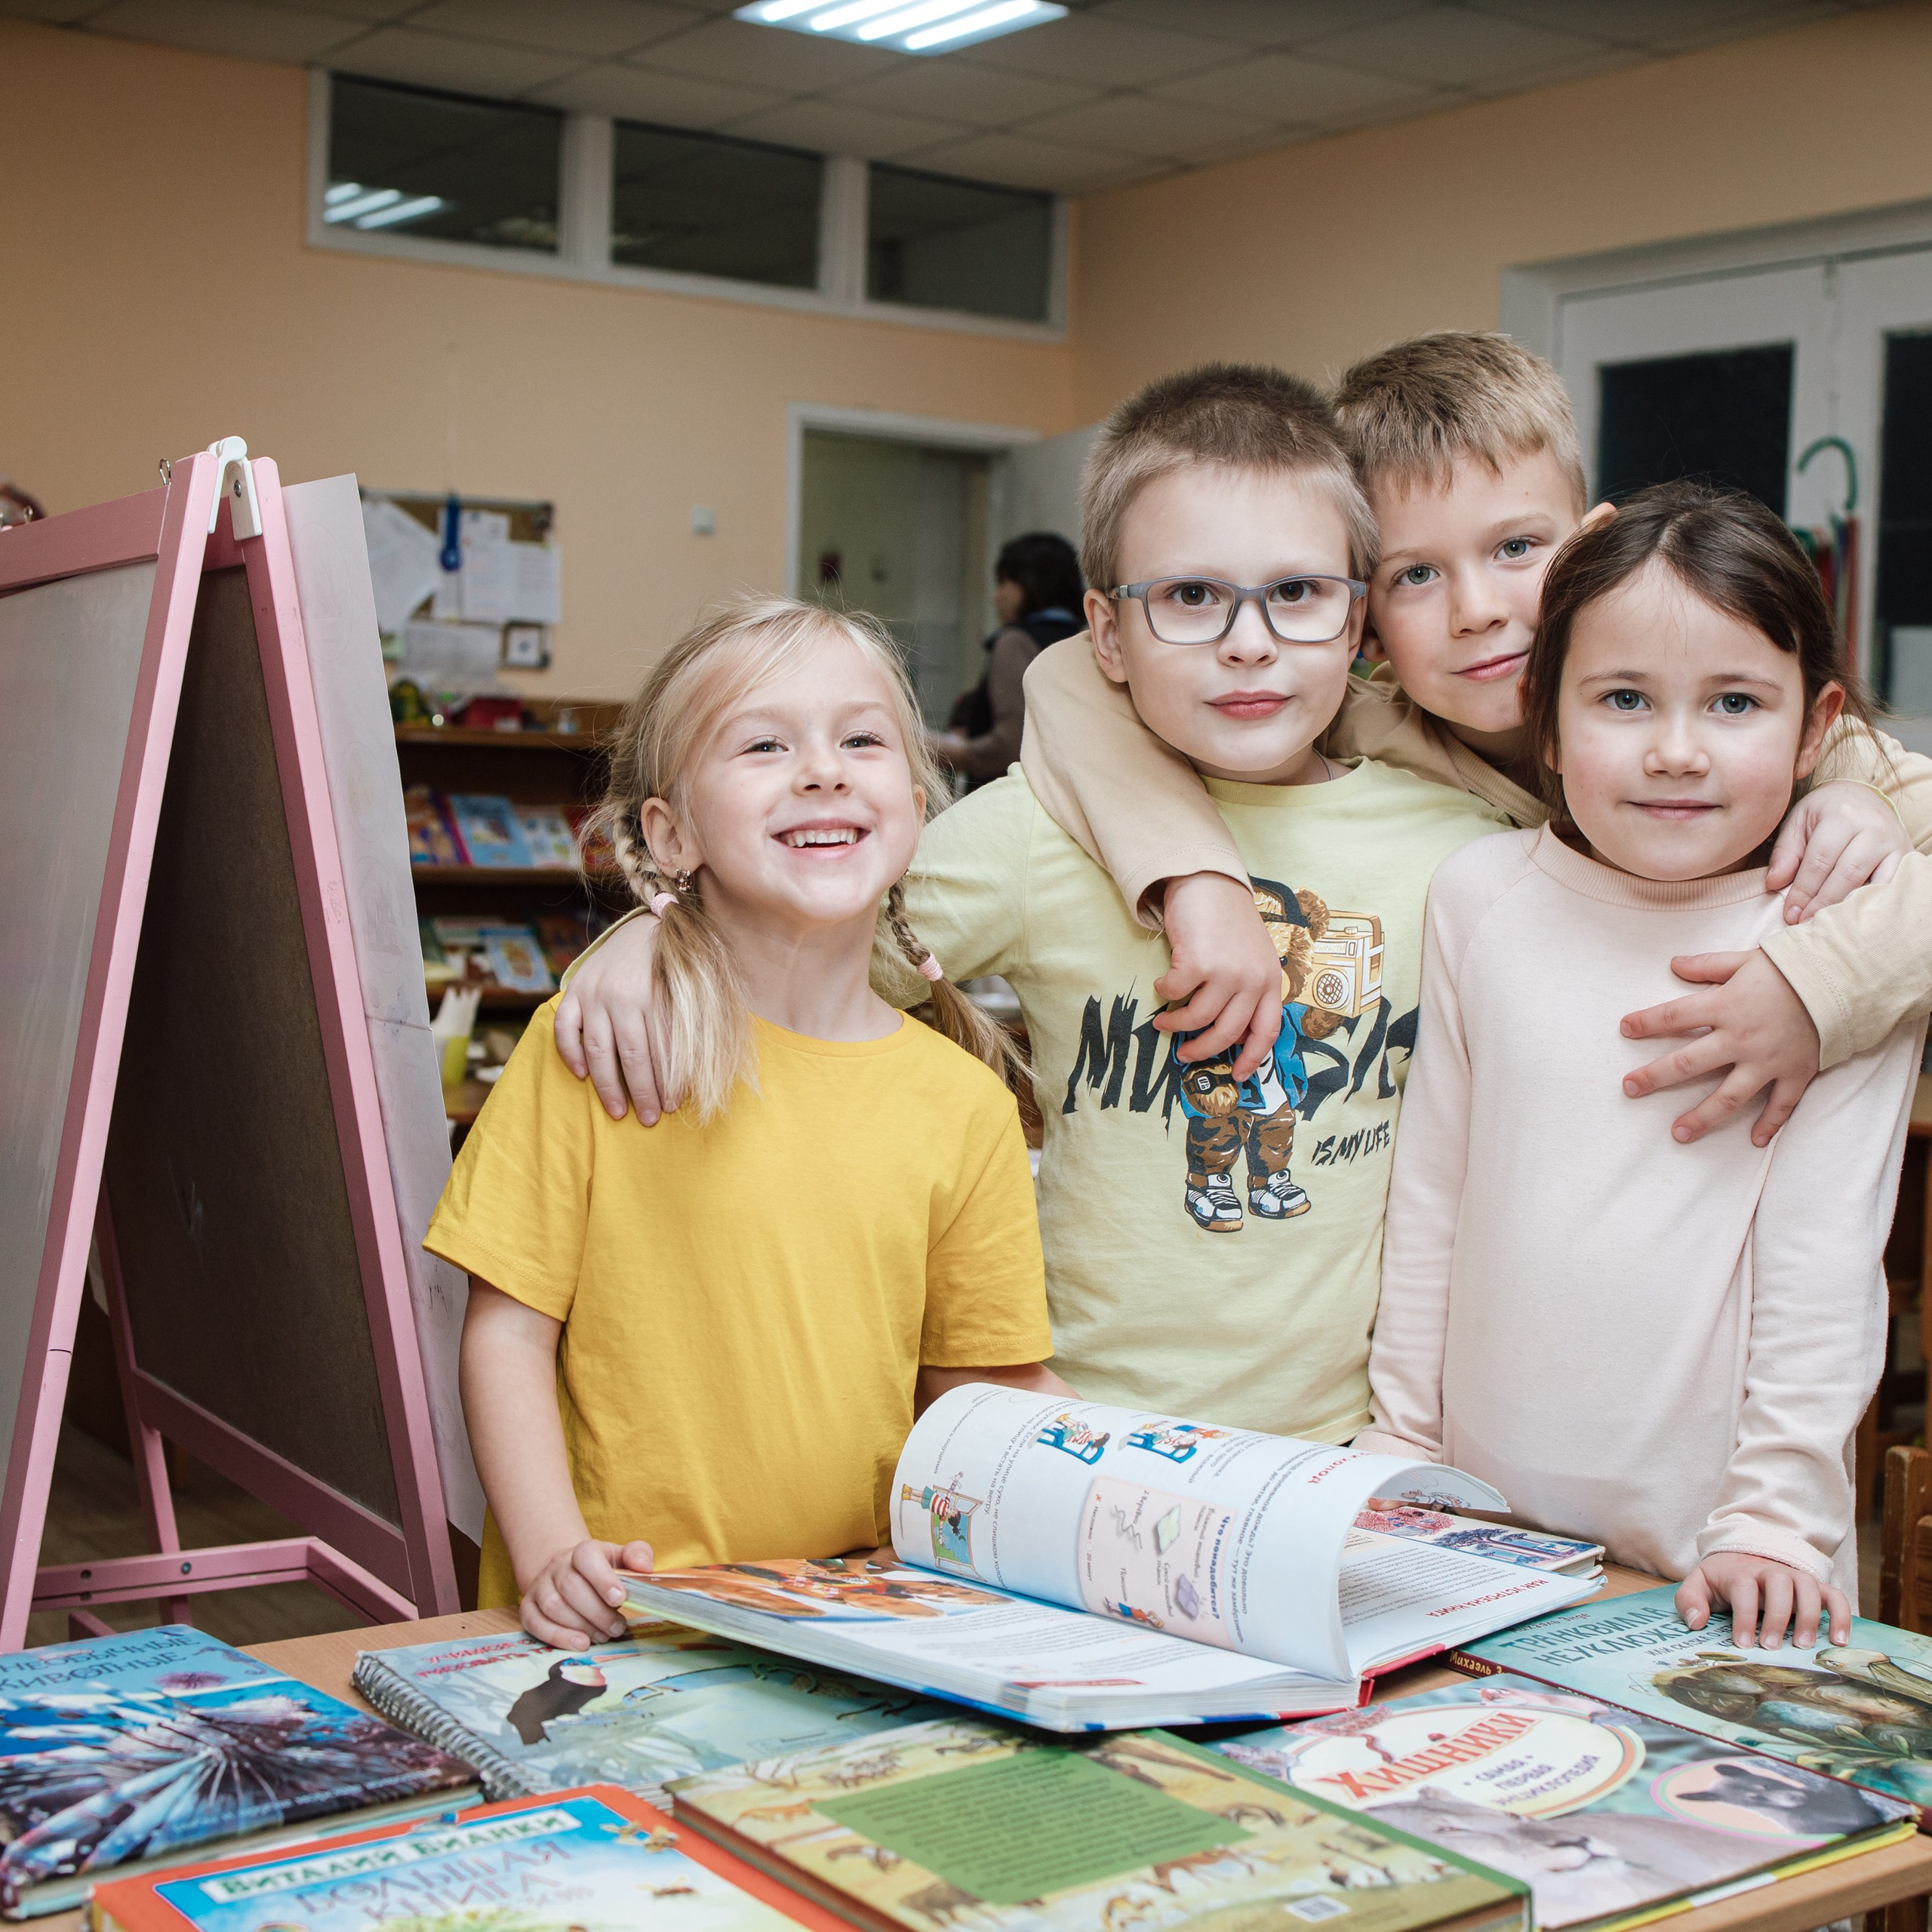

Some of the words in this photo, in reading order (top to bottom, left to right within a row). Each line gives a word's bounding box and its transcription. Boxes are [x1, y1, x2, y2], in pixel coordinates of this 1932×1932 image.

[1311, 1135, 1337, 1166] IS
[1328, 1128, 1366, 1166] MY
[1363, 1119, 1390, 1158] LIFE
[949, 1408, 974, 1437] появились
[1011, 1424, 1027, 1444] улицу
[1018, 1431, 1033, 1448] Если
[934, 1438, 951, 1474] ощущения
[994, 1451, 1010, 1477] встать
[1012, 1449, 1020, 1458] на
[990, 1478, 997, 1488] на
[1001, 1458, 1014, 1484] улице
[984, 1490, 994, 1515] ветру.
[995, 1485, 1004, 1506] сухо,
[1261, 1470, 1292, 1512] проливной
[993, 1508, 999, 1519] не
[1088, 1506, 1099, 1540] Несложно
[1217, 1515, 1230, 1536] Что
[1238, 1507, 1254, 1545] главное
[1249, 1512, 1263, 1548] дождь?
[1087, 1552, 1092, 1561] 20
[1243, 1550, 1253, 1567] Это
[1209, 1539, 1220, 1620] понадобится?
[1231, 1576, 1236, 1590] же
[1521, 1578, 1550, 1592] КАК
[1463, 1586, 1524, 1607] УСТРОЕНА
[1425, 1604, 1469, 1617] КНИГА
[1497, 1606, 1678, 1652] ТРАНКВИЛЛА
[0, 1636, 200, 1672] НЕОБЫЧНЫЕ
[1644, 1644, 1670, 1657] ИЛИ
[1669, 1635, 1715, 1653] СКАЗКА
[1450, 1651, 1492, 1675] Михаэль
[1317, 1711, 1537, 1801] ХИЩНИКИ
[1475, 1758, 1525, 1781] САМАЯ
[1491, 1755, 1601, 1807] ЭНЦИКЛОПЕДИЯ
[1495, 1764, 1554, 1791] ПЕРВАЯ
[221, 1850, 400, 1895] ВИТАЛИЙ
[411, 1815, 562, 1860] БИАНКИ
[295, 1841, 571, 1913] БОЛЬШАЯ
[362, 1872, 561, 1924] КНИГА
